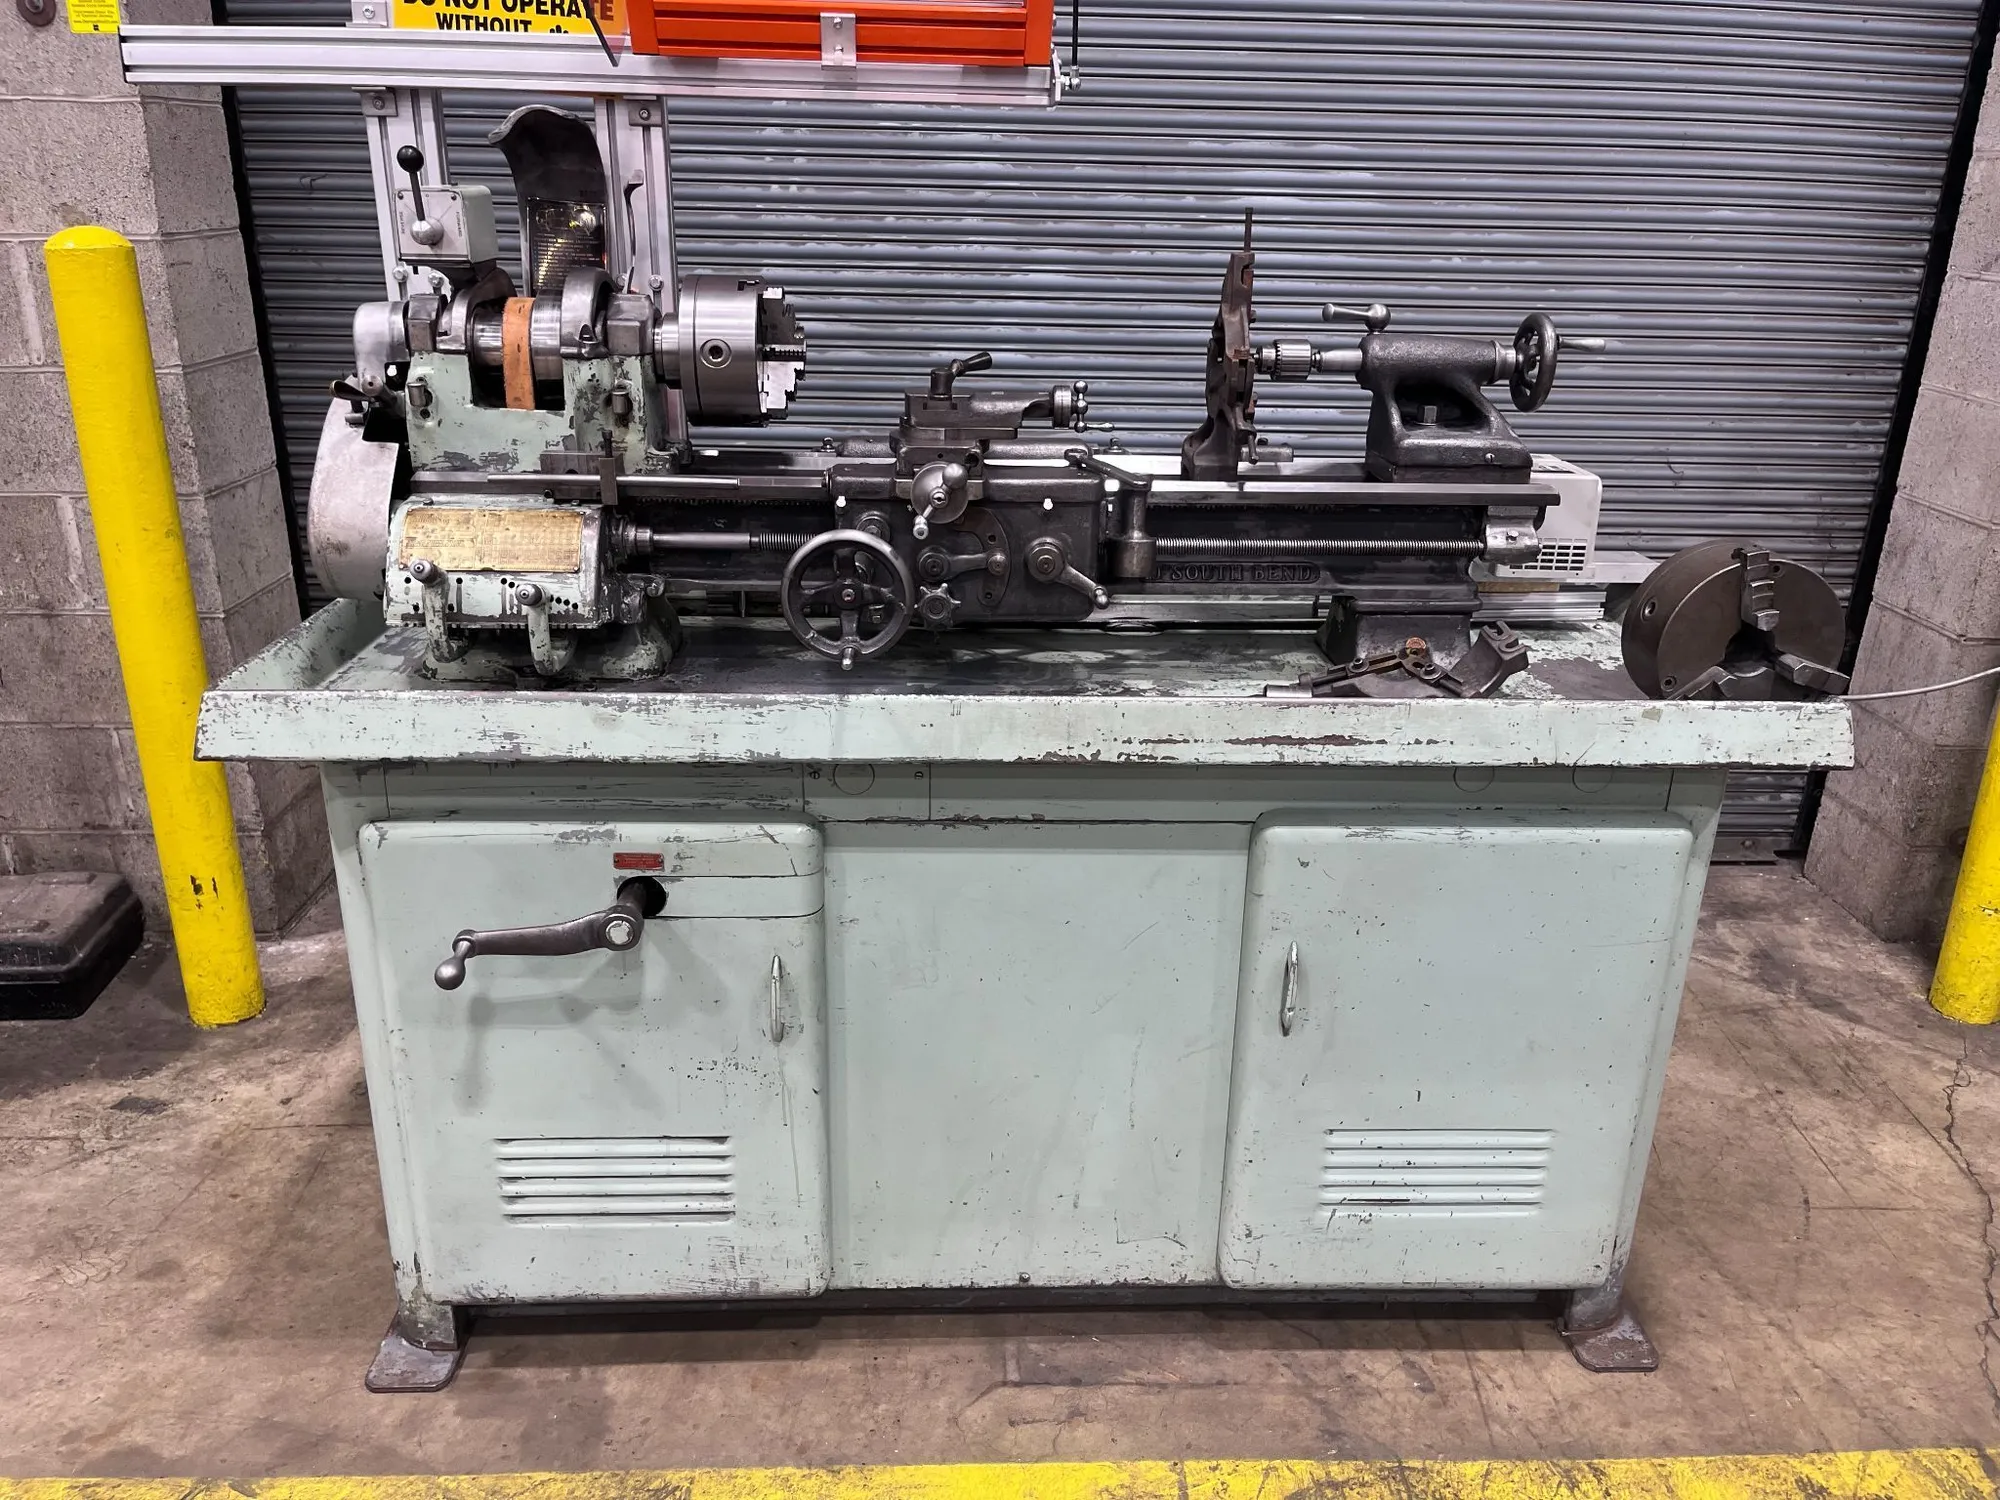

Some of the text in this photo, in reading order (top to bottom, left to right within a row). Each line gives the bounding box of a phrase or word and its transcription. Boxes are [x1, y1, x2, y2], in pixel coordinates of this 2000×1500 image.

[435, 12, 532, 33] WITHOUT
[1171, 563, 1242, 580] SOUTH
[1254, 563, 1312, 580] BEND
